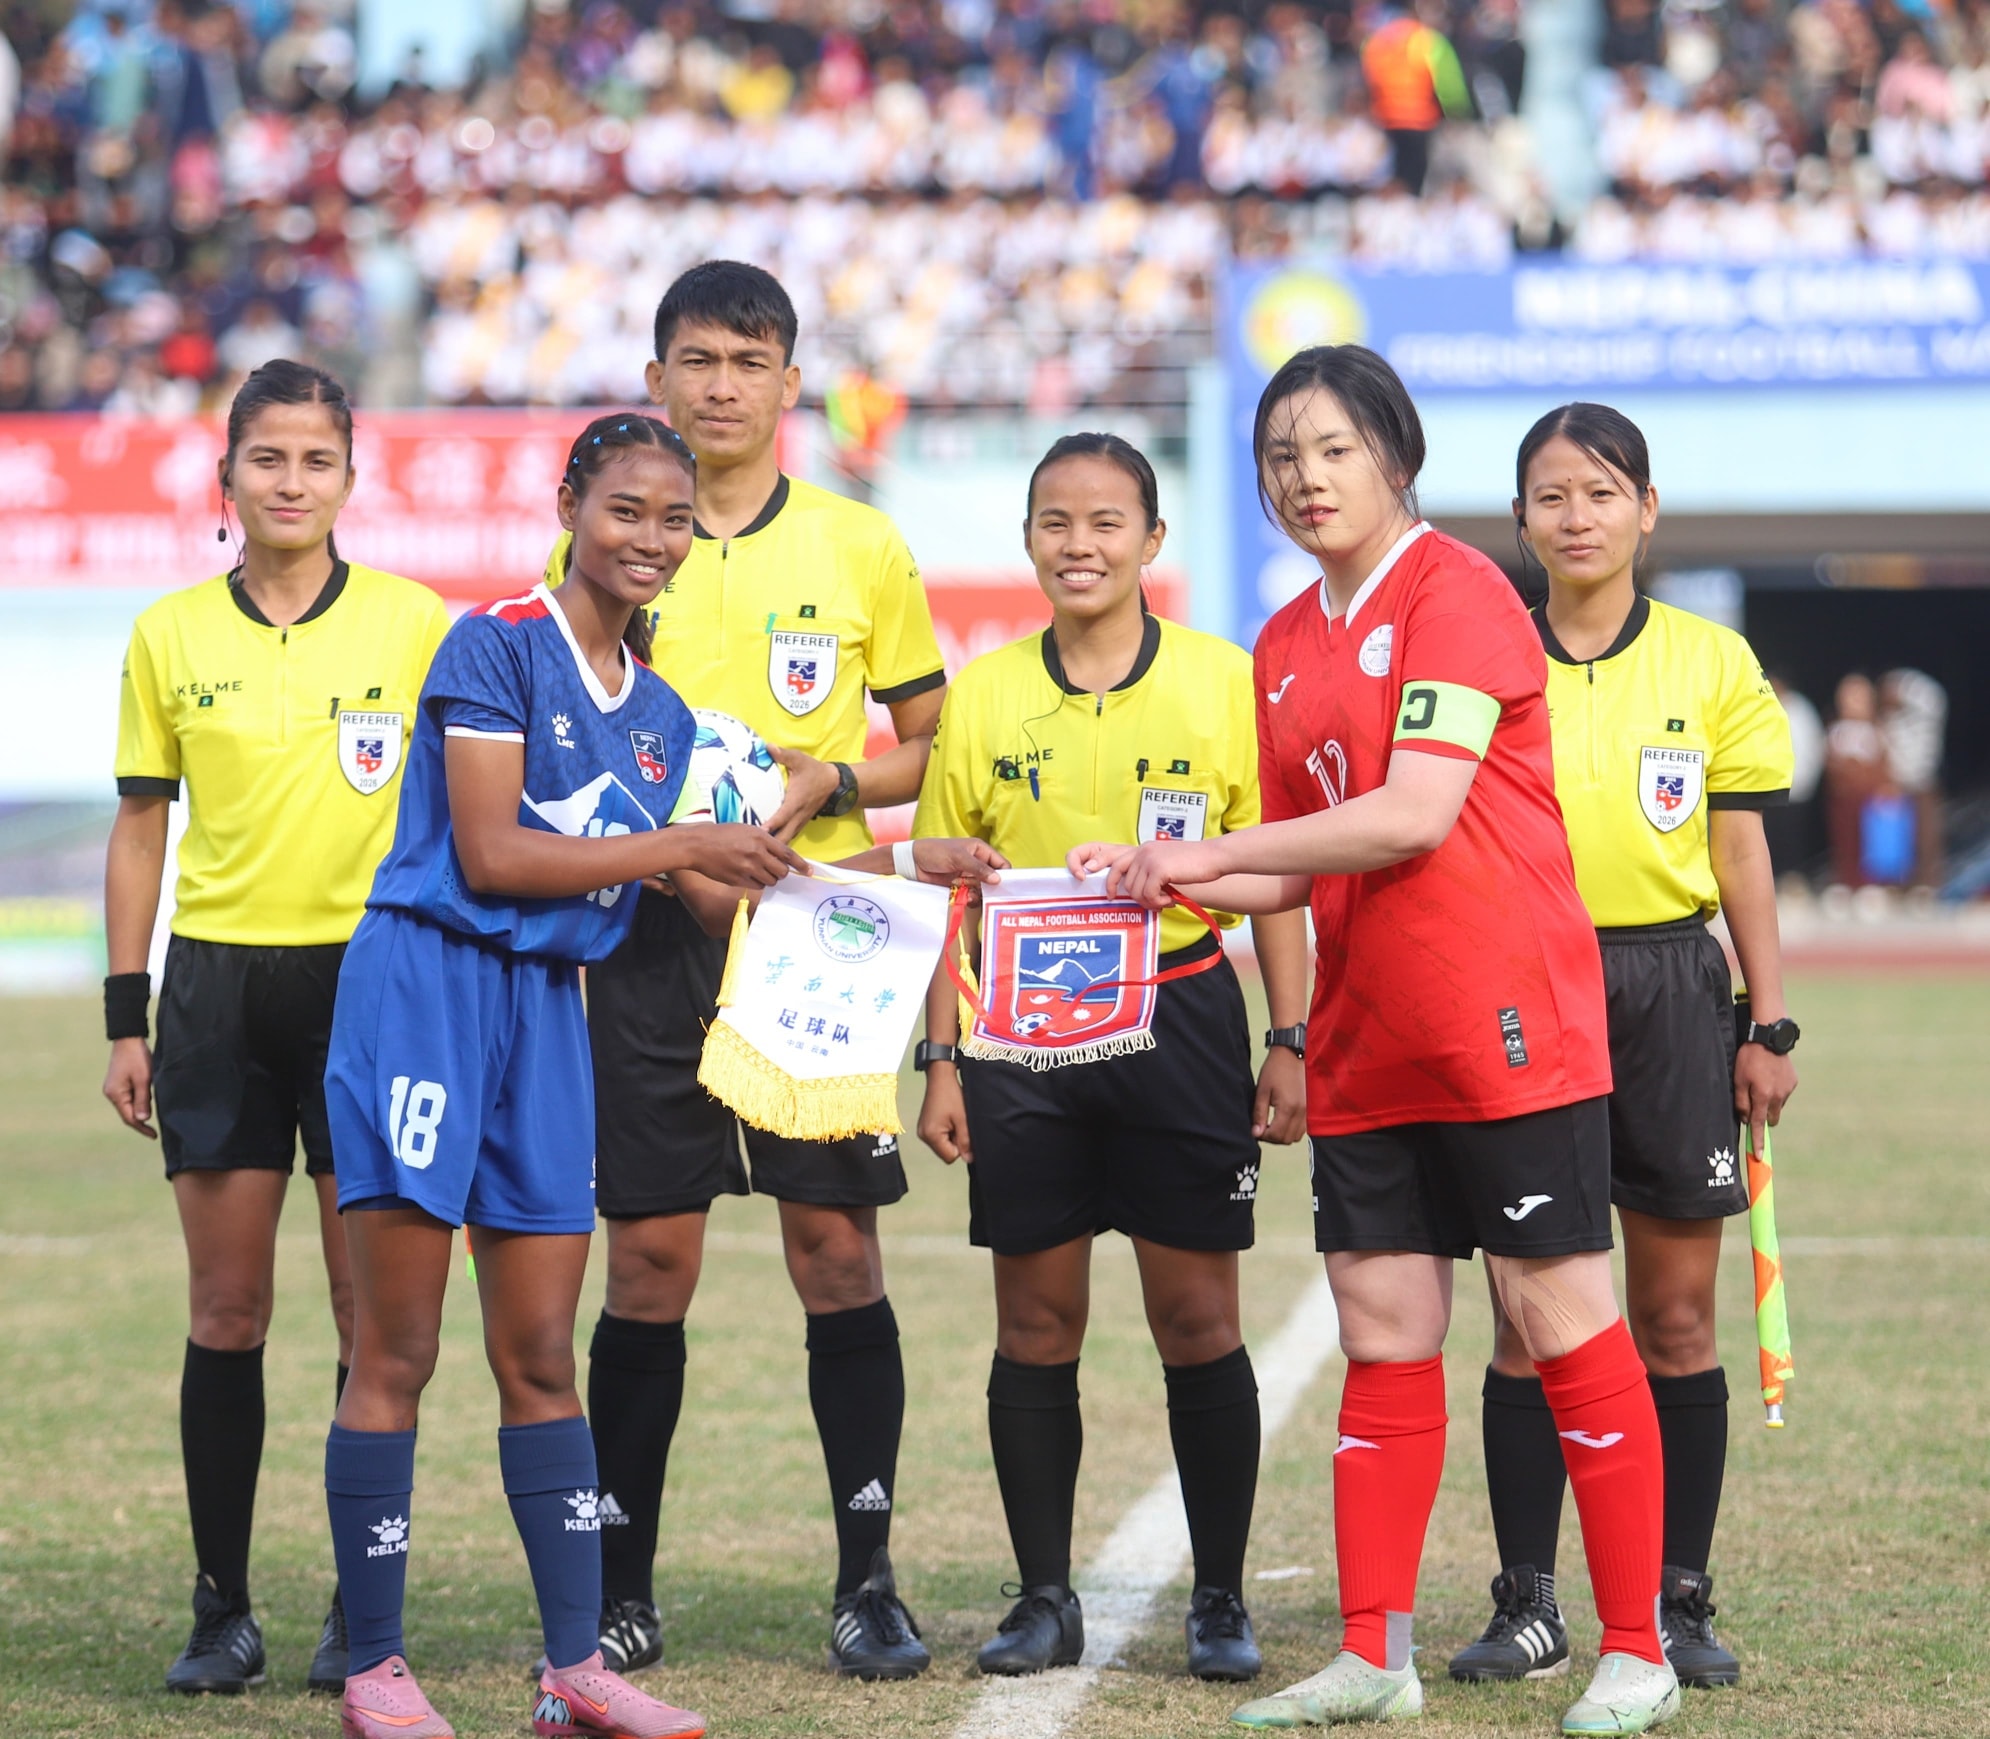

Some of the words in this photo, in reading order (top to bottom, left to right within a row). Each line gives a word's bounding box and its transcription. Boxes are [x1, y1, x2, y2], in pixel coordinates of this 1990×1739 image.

[775, 634, 834, 648] REFEREE
[177, 680, 243, 698] KELME
[789, 699, 810, 709] 2026
[342, 714, 399, 726] REFEREE
[1644, 749, 1700, 764] REFEREE
[359, 778, 378, 788] 2026
[1145, 791, 1204, 807] REFEREE
[1657, 815, 1677, 825] 2026
[1001, 916, 1017, 927] ALL
[1018, 915, 1044, 927] NEPAL
[1045, 913, 1087, 926] FOOTBALL
[1088, 912, 1142, 925] ASSOCIATION
[1038, 939, 1101, 955] NEPAL
[776, 1007, 851, 1045] 足球队
[388, 1075, 447, 1170] 18
[848, 1499, 891, 1511] adidas
